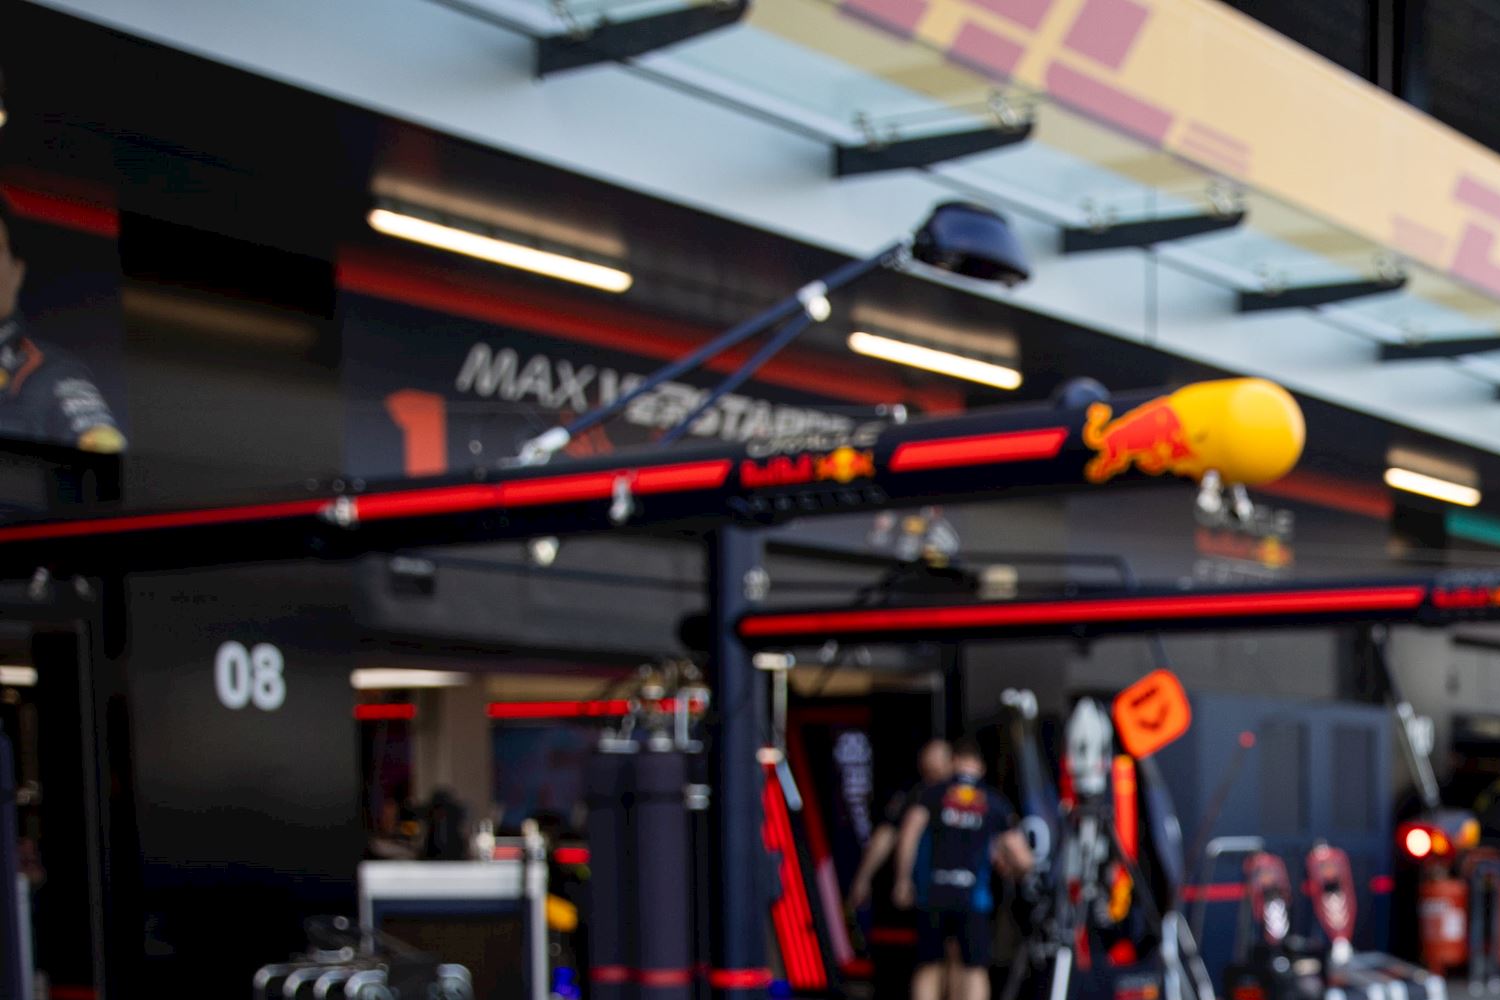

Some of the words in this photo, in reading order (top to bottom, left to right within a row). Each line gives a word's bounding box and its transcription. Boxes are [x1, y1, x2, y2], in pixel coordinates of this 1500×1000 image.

[454, 342, 598, 412] MAX
[385, 388, 448, 477] 1
[214, 639, 286, 712] 08
